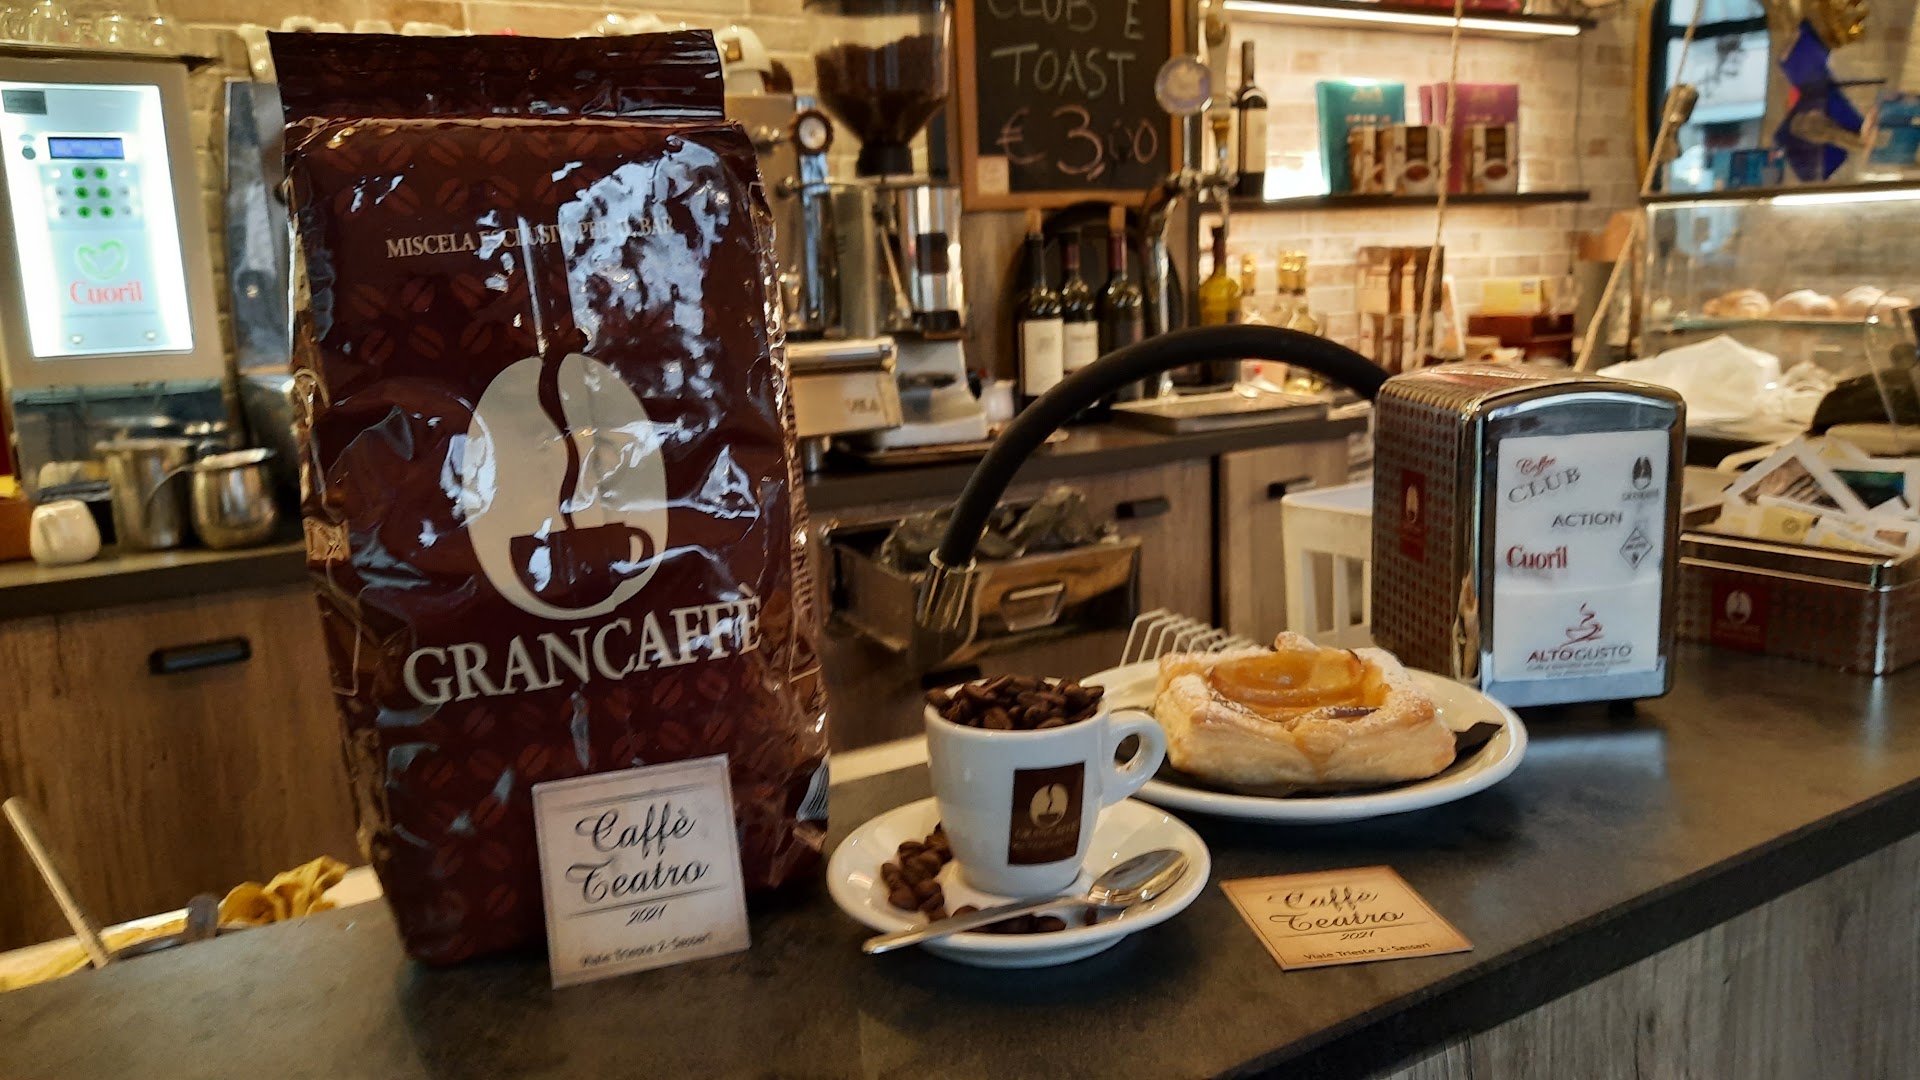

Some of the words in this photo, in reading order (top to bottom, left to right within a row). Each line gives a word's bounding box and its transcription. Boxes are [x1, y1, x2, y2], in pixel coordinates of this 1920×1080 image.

[991, 43, 1136, 104] TOAST
[386, 231, 476, 258] MISCELA
[70, 281, 143, 305] Cuoril
[1508, 466, 1581, 503] CLUB
[1551, 511, 1623, 529] ACTION
[1506, 545, 1569, 570] Cuoril
[1526, 644, 1633, 664] ALTOGUSTO
[575, 801, 697, 859] Caffè
[565, 856, 710, 904] Teatro
[1269, 911, 1404, 932] Teatro
[1340, 930, 1374, 941] 2021
[1303, 952, 1334, 961] Viale
[1335, 948, 1375, 958] Trieste
[1391, 942, 1431, 952] Sassari
